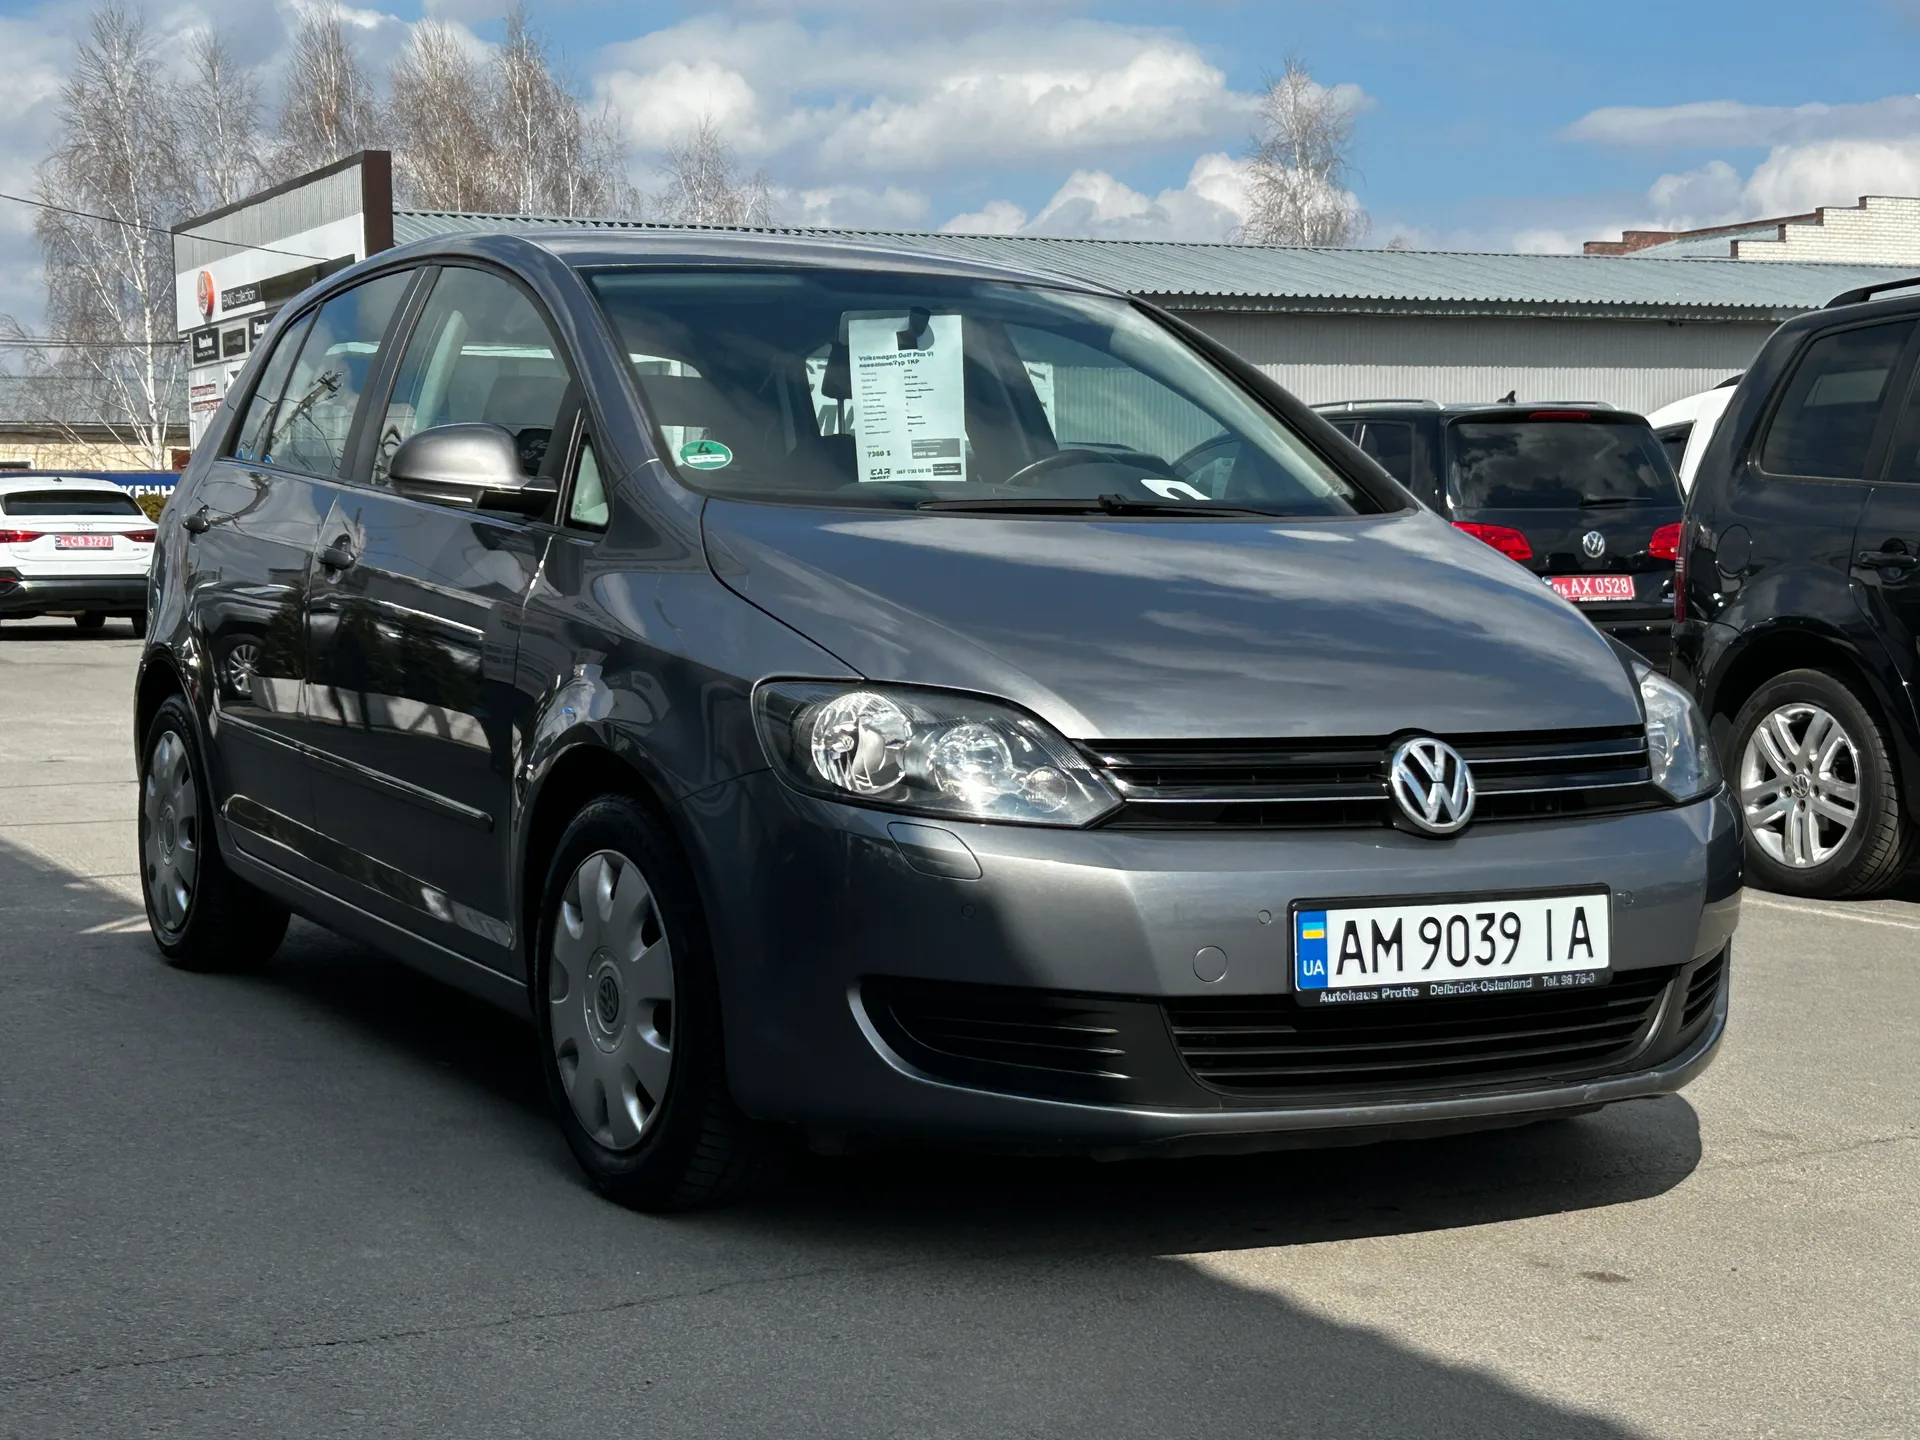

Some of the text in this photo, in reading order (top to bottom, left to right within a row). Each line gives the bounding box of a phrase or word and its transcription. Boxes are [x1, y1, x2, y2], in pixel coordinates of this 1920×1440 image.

[870, 467, 892, 476] CAR
[87, 535, 110, 547] 3727
[1571, 577, 1592, 594] AX
[1595, 577, 1629, 594] 0528
[1336, 906, 1594, 975] AM 9039 IA
[1303, 959, 1325, 977] UA
[1319, 989, 1378, 1003] Autohaus
[1381, 986, 1420, 1000] Protte
[1542, 975, 1560, 987] Tel.
